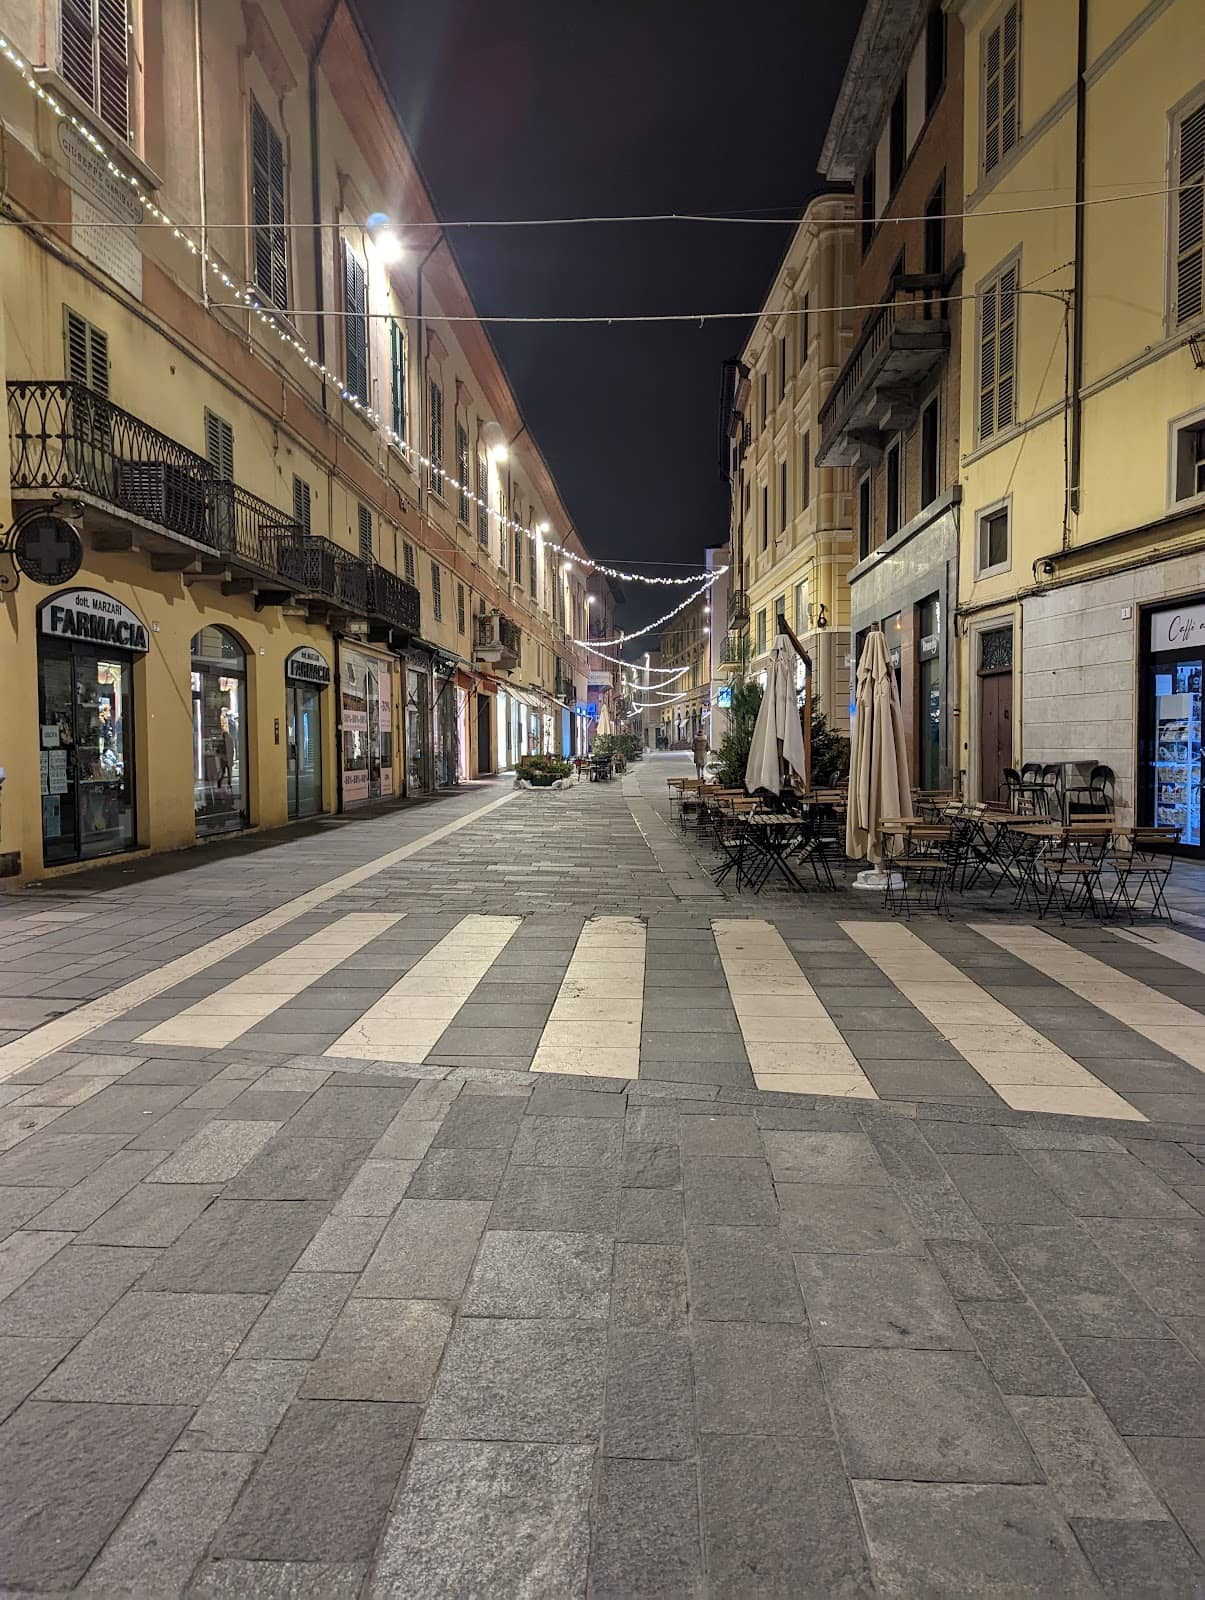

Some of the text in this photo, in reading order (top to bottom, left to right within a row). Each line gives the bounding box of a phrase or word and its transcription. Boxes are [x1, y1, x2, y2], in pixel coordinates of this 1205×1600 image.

[75, 594, 122, 616] dott. MARZARI
[50, 605, 147, 648] FARMACIA
